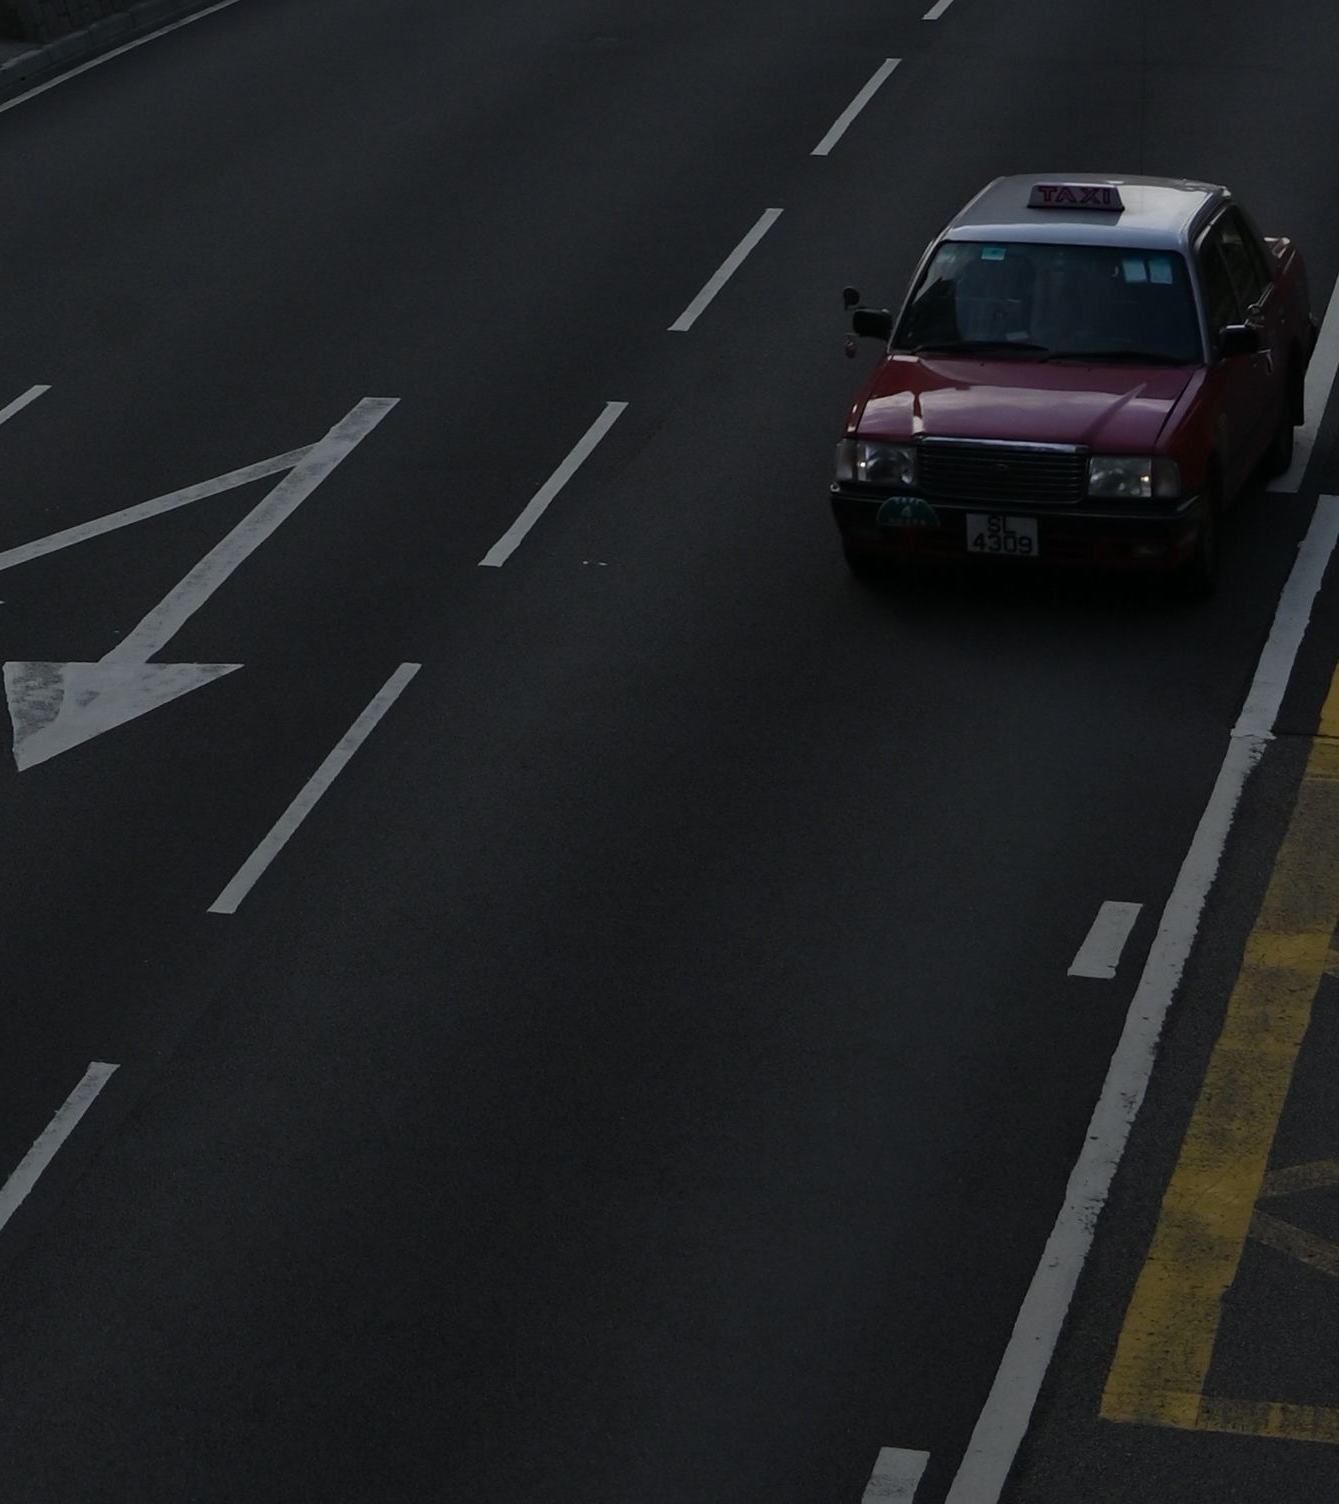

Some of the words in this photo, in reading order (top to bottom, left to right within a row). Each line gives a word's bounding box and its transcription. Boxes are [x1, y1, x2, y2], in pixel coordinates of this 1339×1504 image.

[1038, 185, 1111, 205] TAXI
[988, 514, 1016, 535] SL
[973, 533, 1032, 555] 4309
